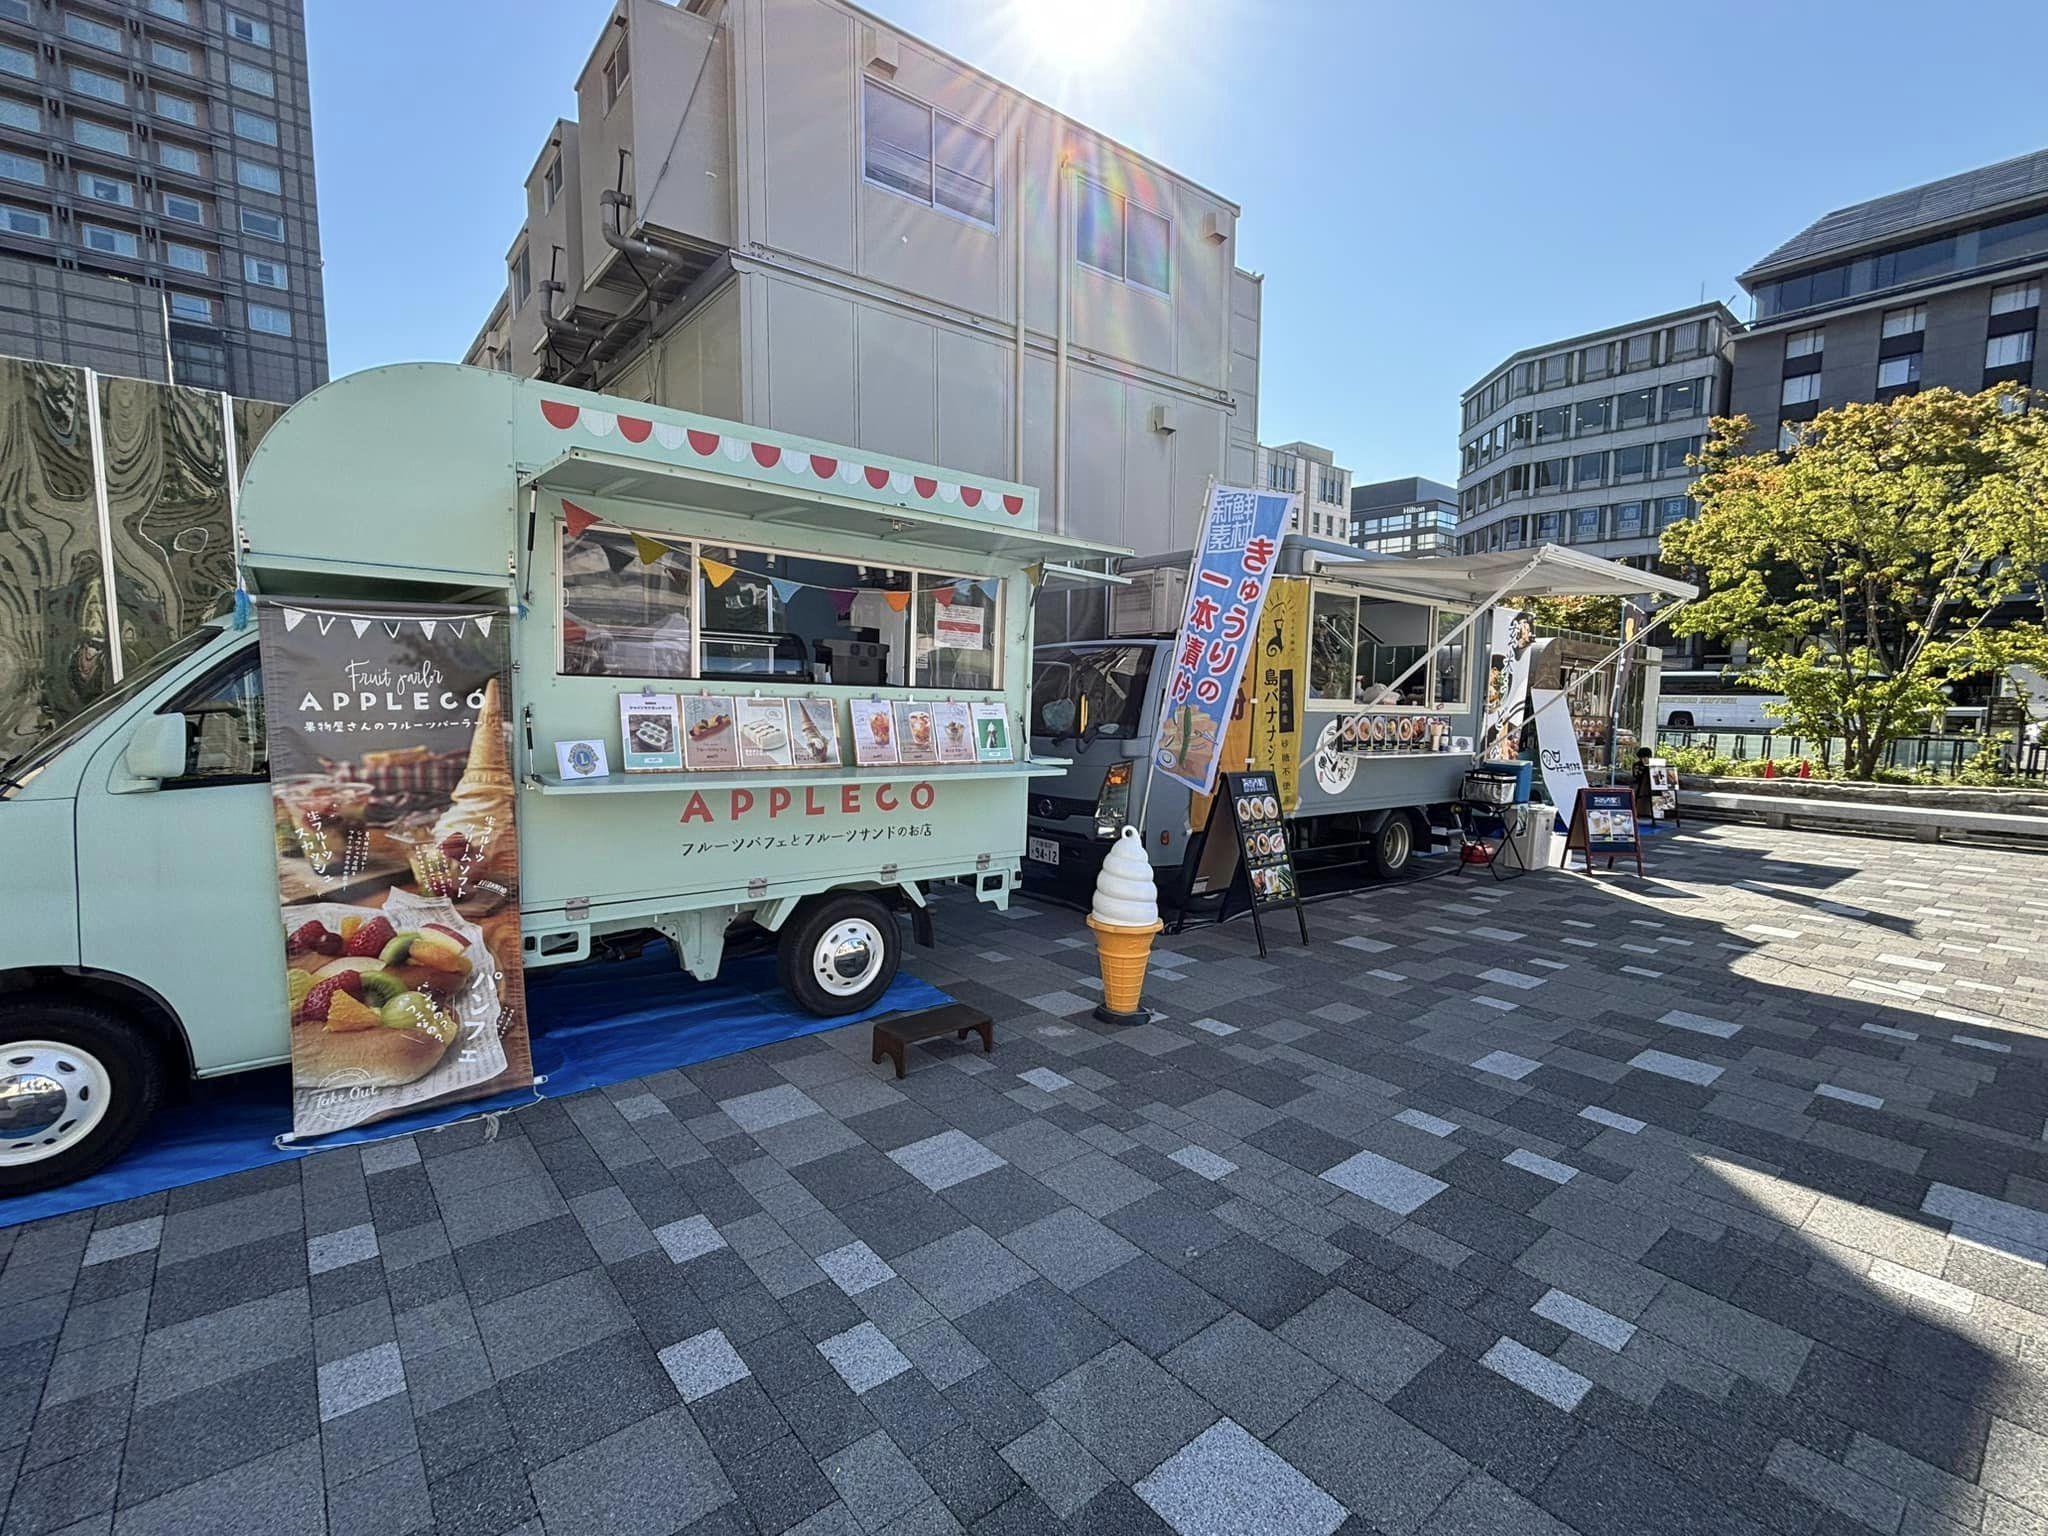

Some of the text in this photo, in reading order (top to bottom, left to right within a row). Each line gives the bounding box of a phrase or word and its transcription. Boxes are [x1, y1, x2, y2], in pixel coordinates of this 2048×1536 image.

[1211, 493, 1255, 522] 新鮮
[1403, 505, 1426, 514] Hilton
[1209, 521, 1252, 550] 素材
[1171, 571, 1230, 702] 一本漬け
[1197, 538, 1274, 700] きゅうりの
[345, 659, 443, 695] Fruit parlor
[307, 810, 333, 860] 生フルーツ
[475, 815, 496, 862] 生フルーツ
[682, 823, 933, 856] フルーツパフェとフルーツサンドのお店
[295, 827, 335, 882] スカッシュ
[313, 1084, 378, 1109] Take Out
